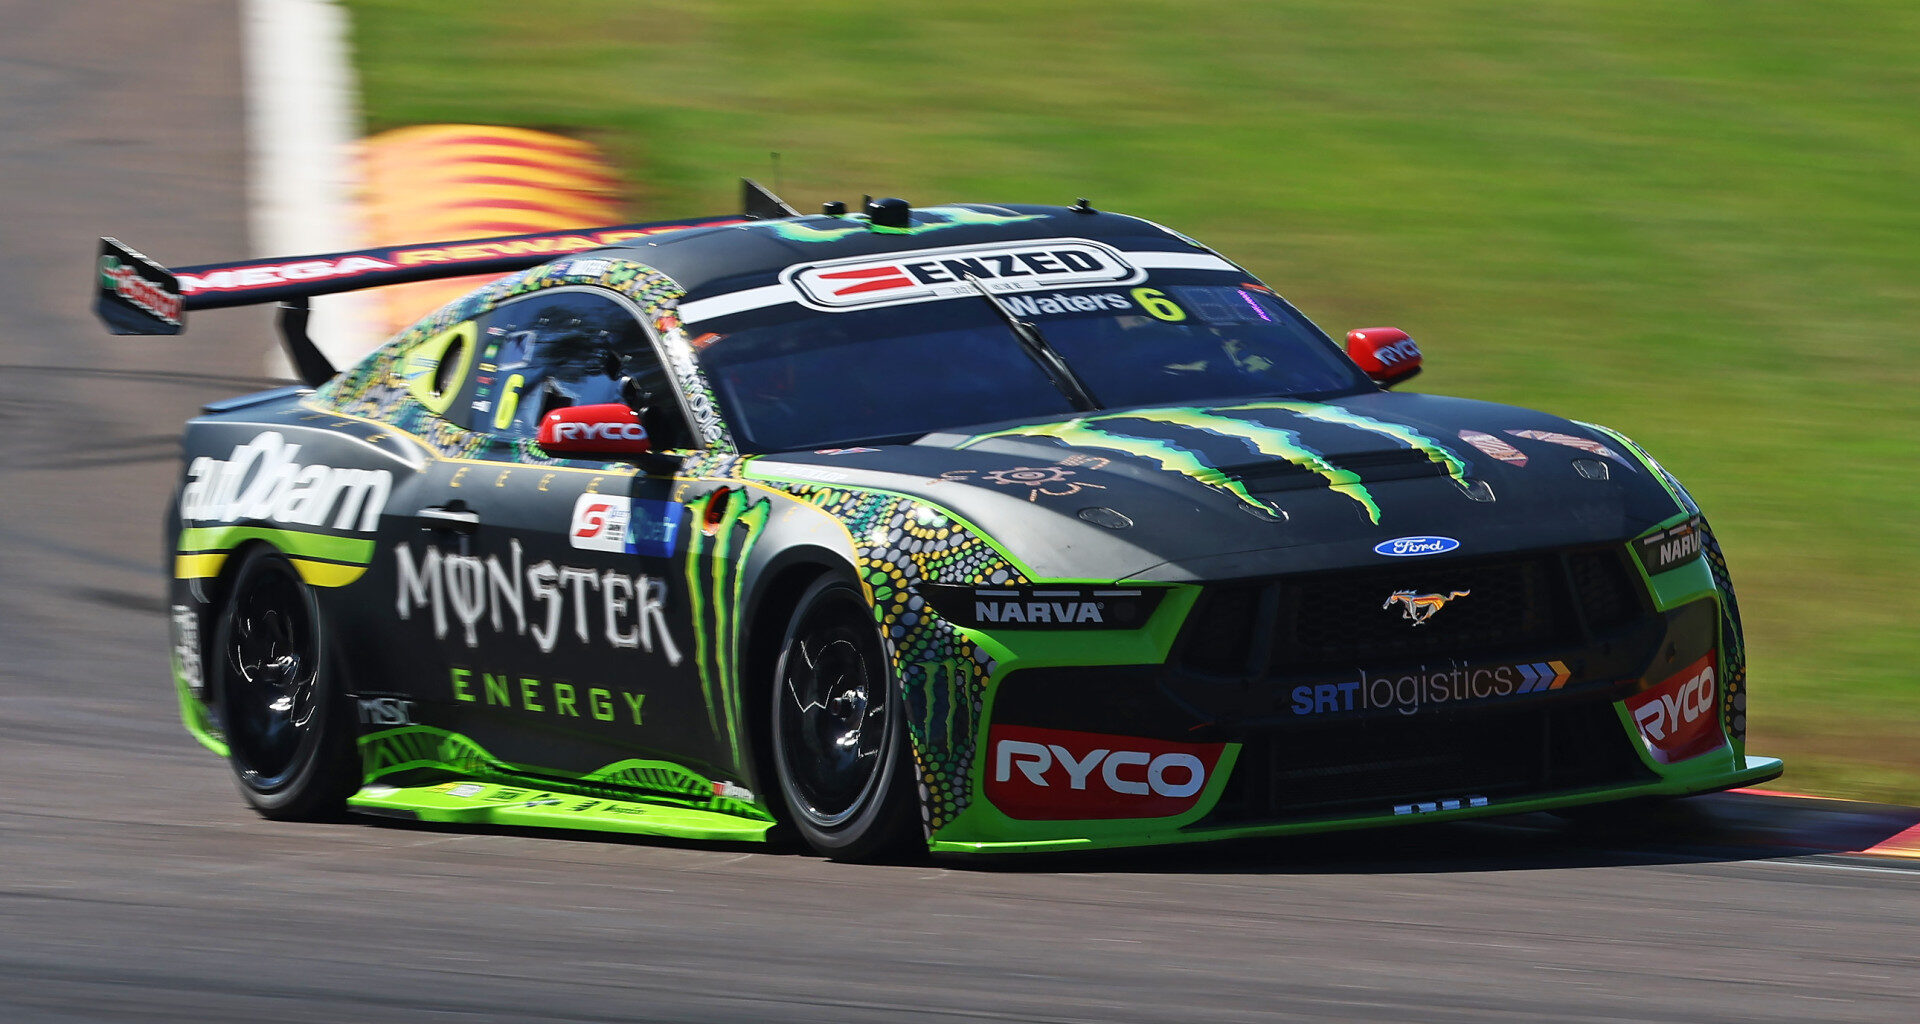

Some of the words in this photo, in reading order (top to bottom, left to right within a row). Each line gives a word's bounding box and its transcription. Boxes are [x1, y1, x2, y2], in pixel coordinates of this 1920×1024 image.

[178, 257, 398, 291] MEGA
[902, 251, 1104, 284] ENZED
[998, 289, 1132, 317] Waters
[1129, 287, 1187, 322] 6
[494, 374, 525, 430] 6
[552, 422, 648, 443] RYCO
[1660, 529, 1702, 566] NARV
[395, 538, 683, 668] MONSTER
[450, 667, 646, 726] ENERGY
[1634, 665, 1715, 741] RYCO
[995, 739, 1205, 798] RYCO
